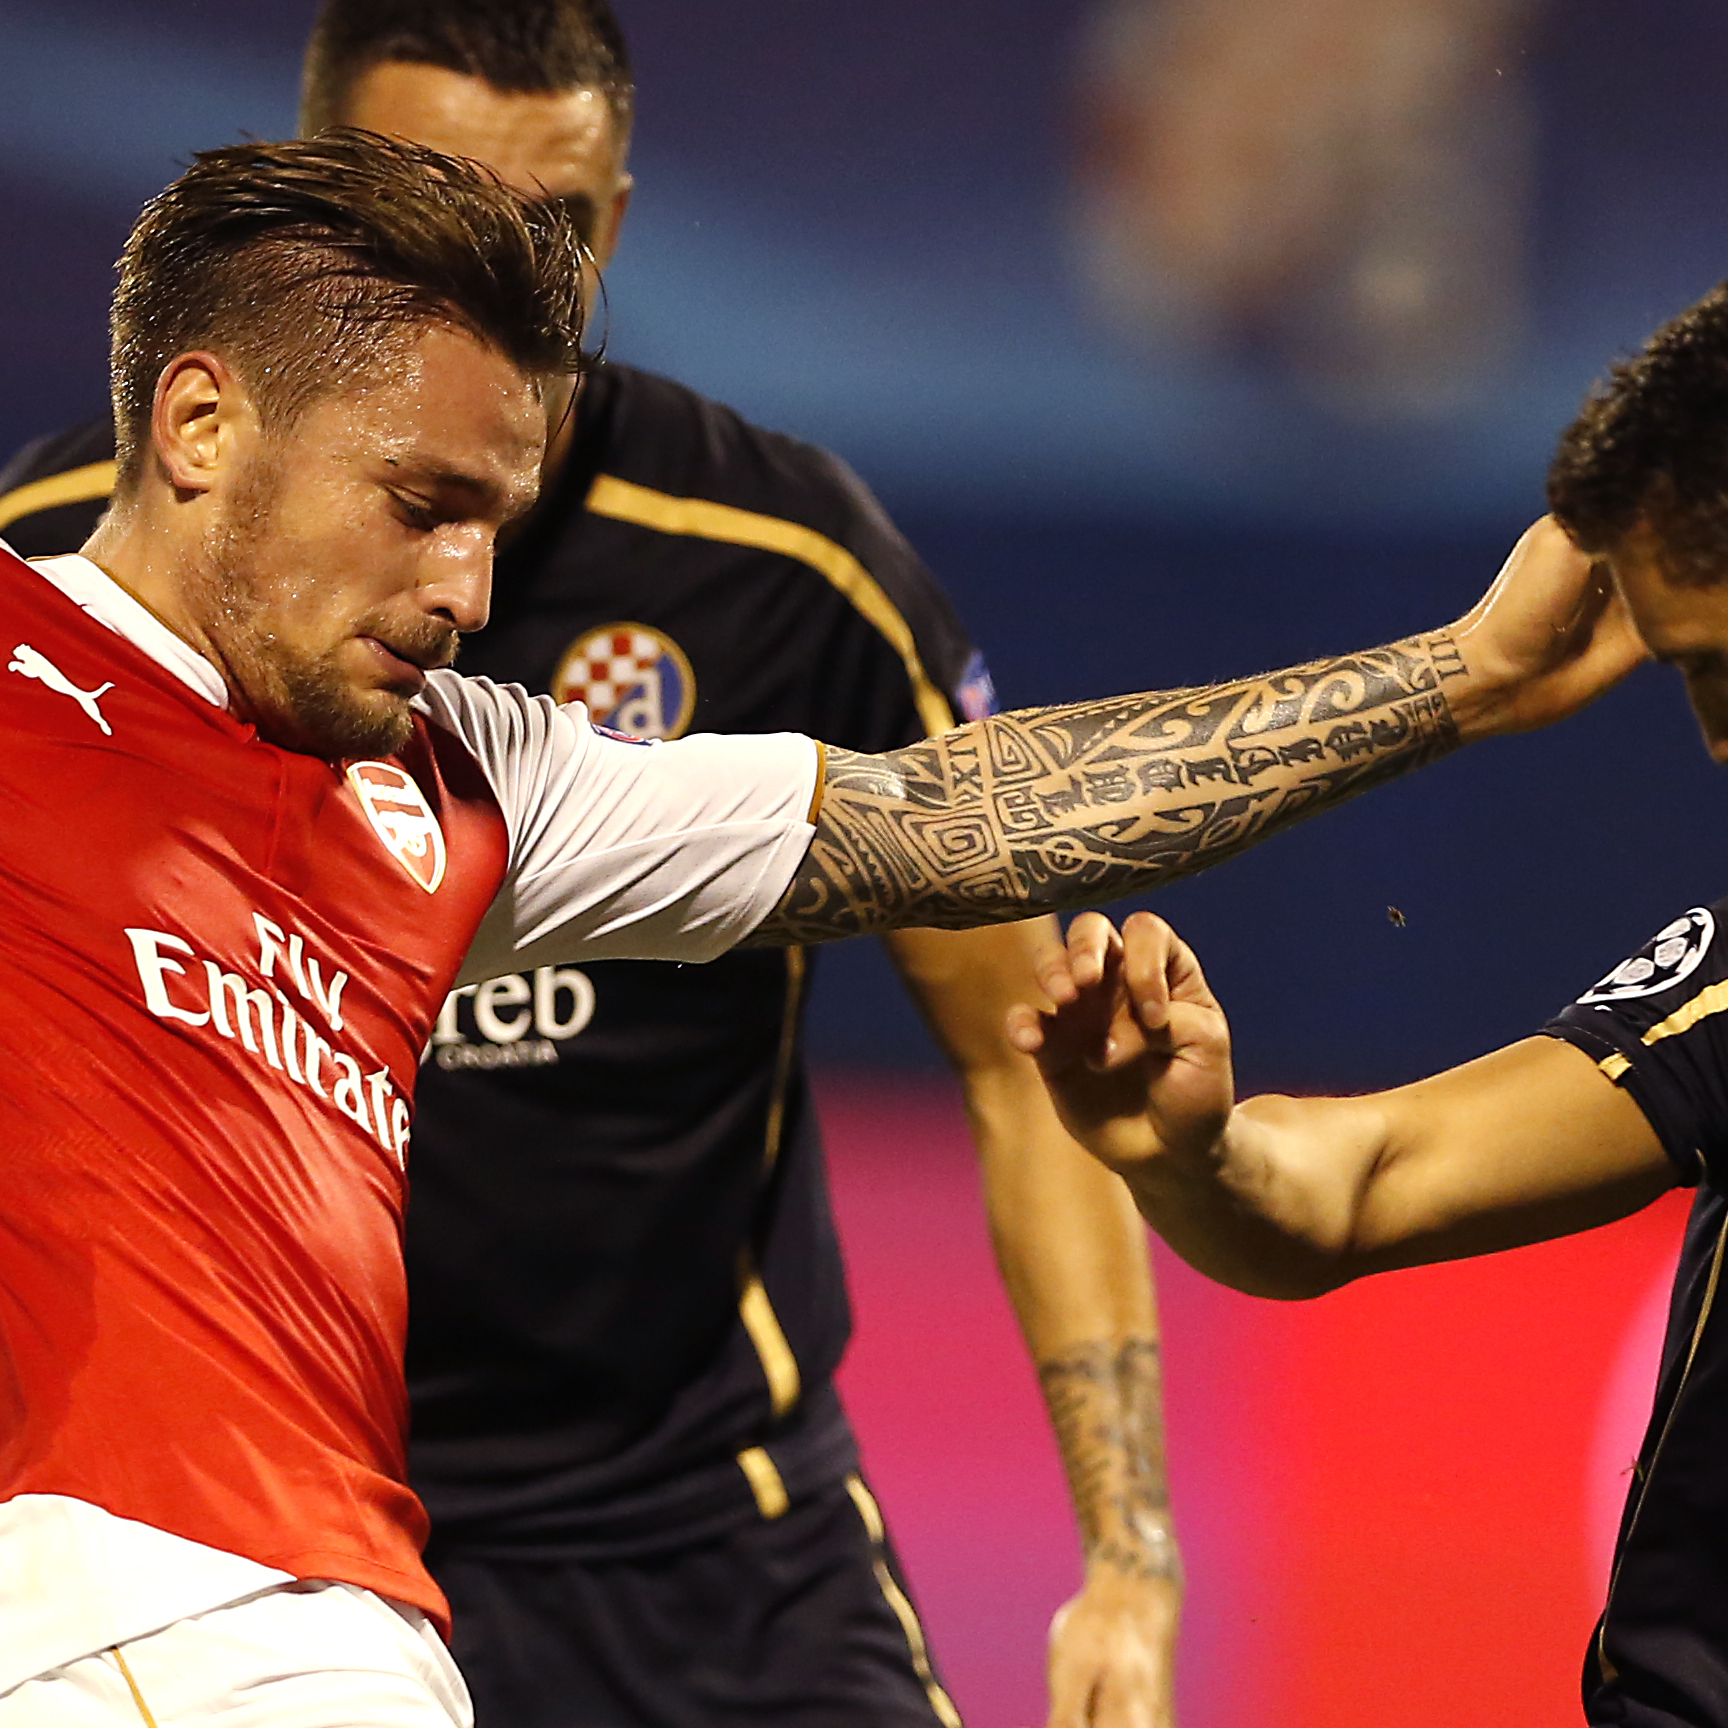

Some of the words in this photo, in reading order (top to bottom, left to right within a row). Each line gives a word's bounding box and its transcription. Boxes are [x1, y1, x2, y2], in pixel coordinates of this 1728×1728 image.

[252, 911, 348, 1031] Fly
[422, 965, 596, 1050] reb
[124, 928, 411, 1171] Emirate
